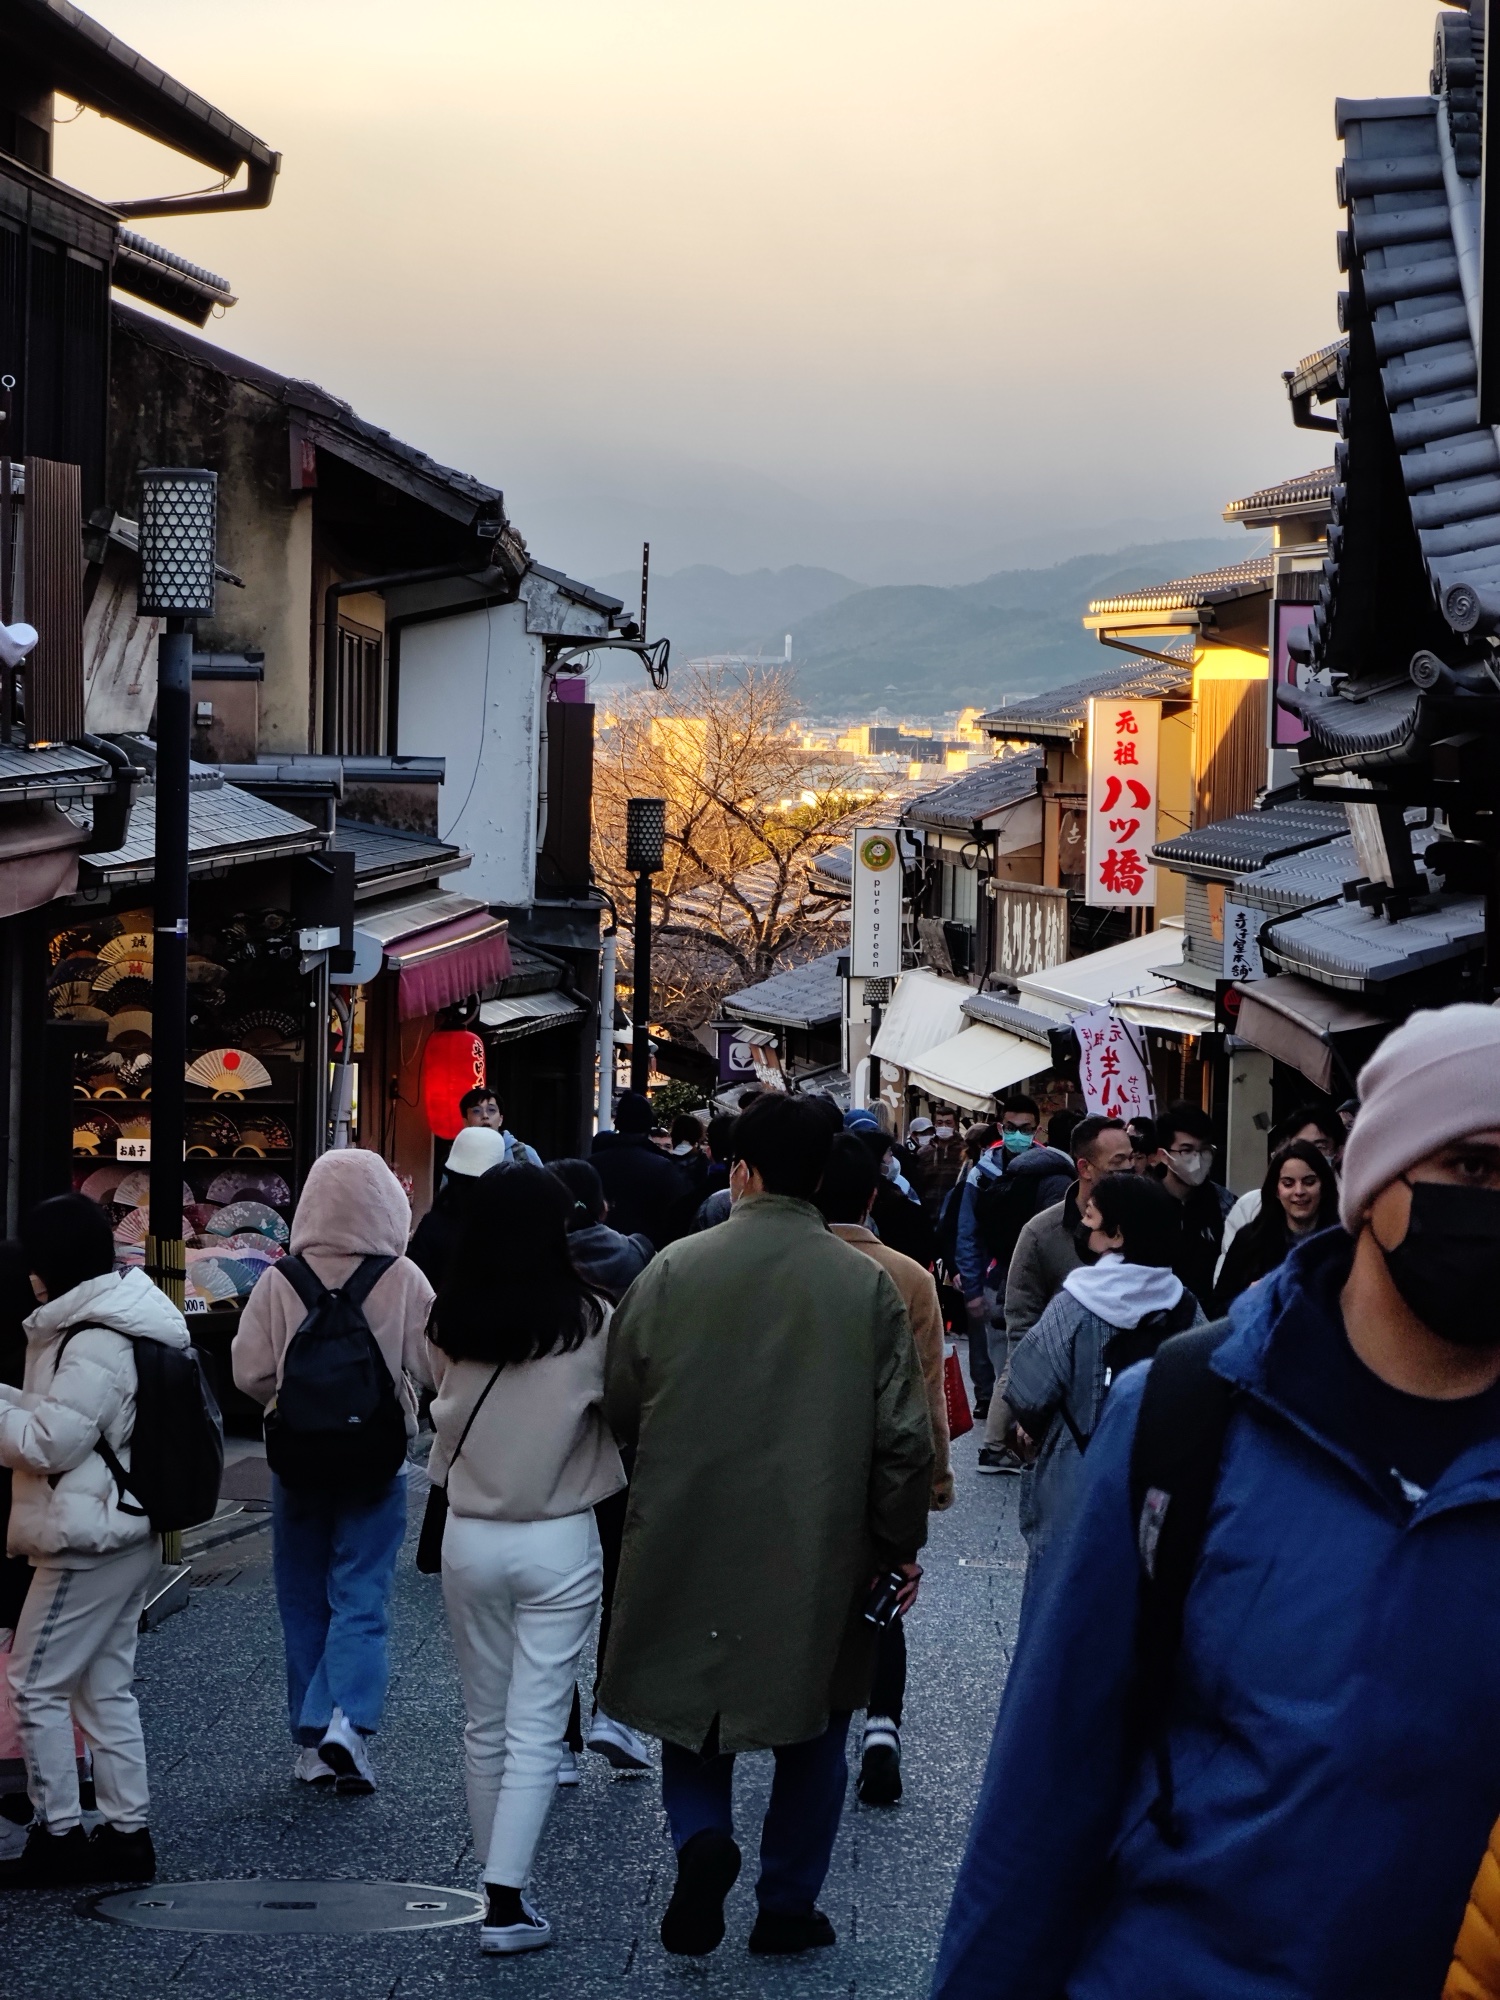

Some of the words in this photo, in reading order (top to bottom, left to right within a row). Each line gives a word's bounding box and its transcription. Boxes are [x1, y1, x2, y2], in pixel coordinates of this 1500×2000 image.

[873, 879, 881, 915] pure
[131, 935, 147, 948] 誠
[872, 922, 880, 968] green
[1231, 911, 1253, 981] 寺子屋本舗
[120, 1144, 147, 1157] お扇子
